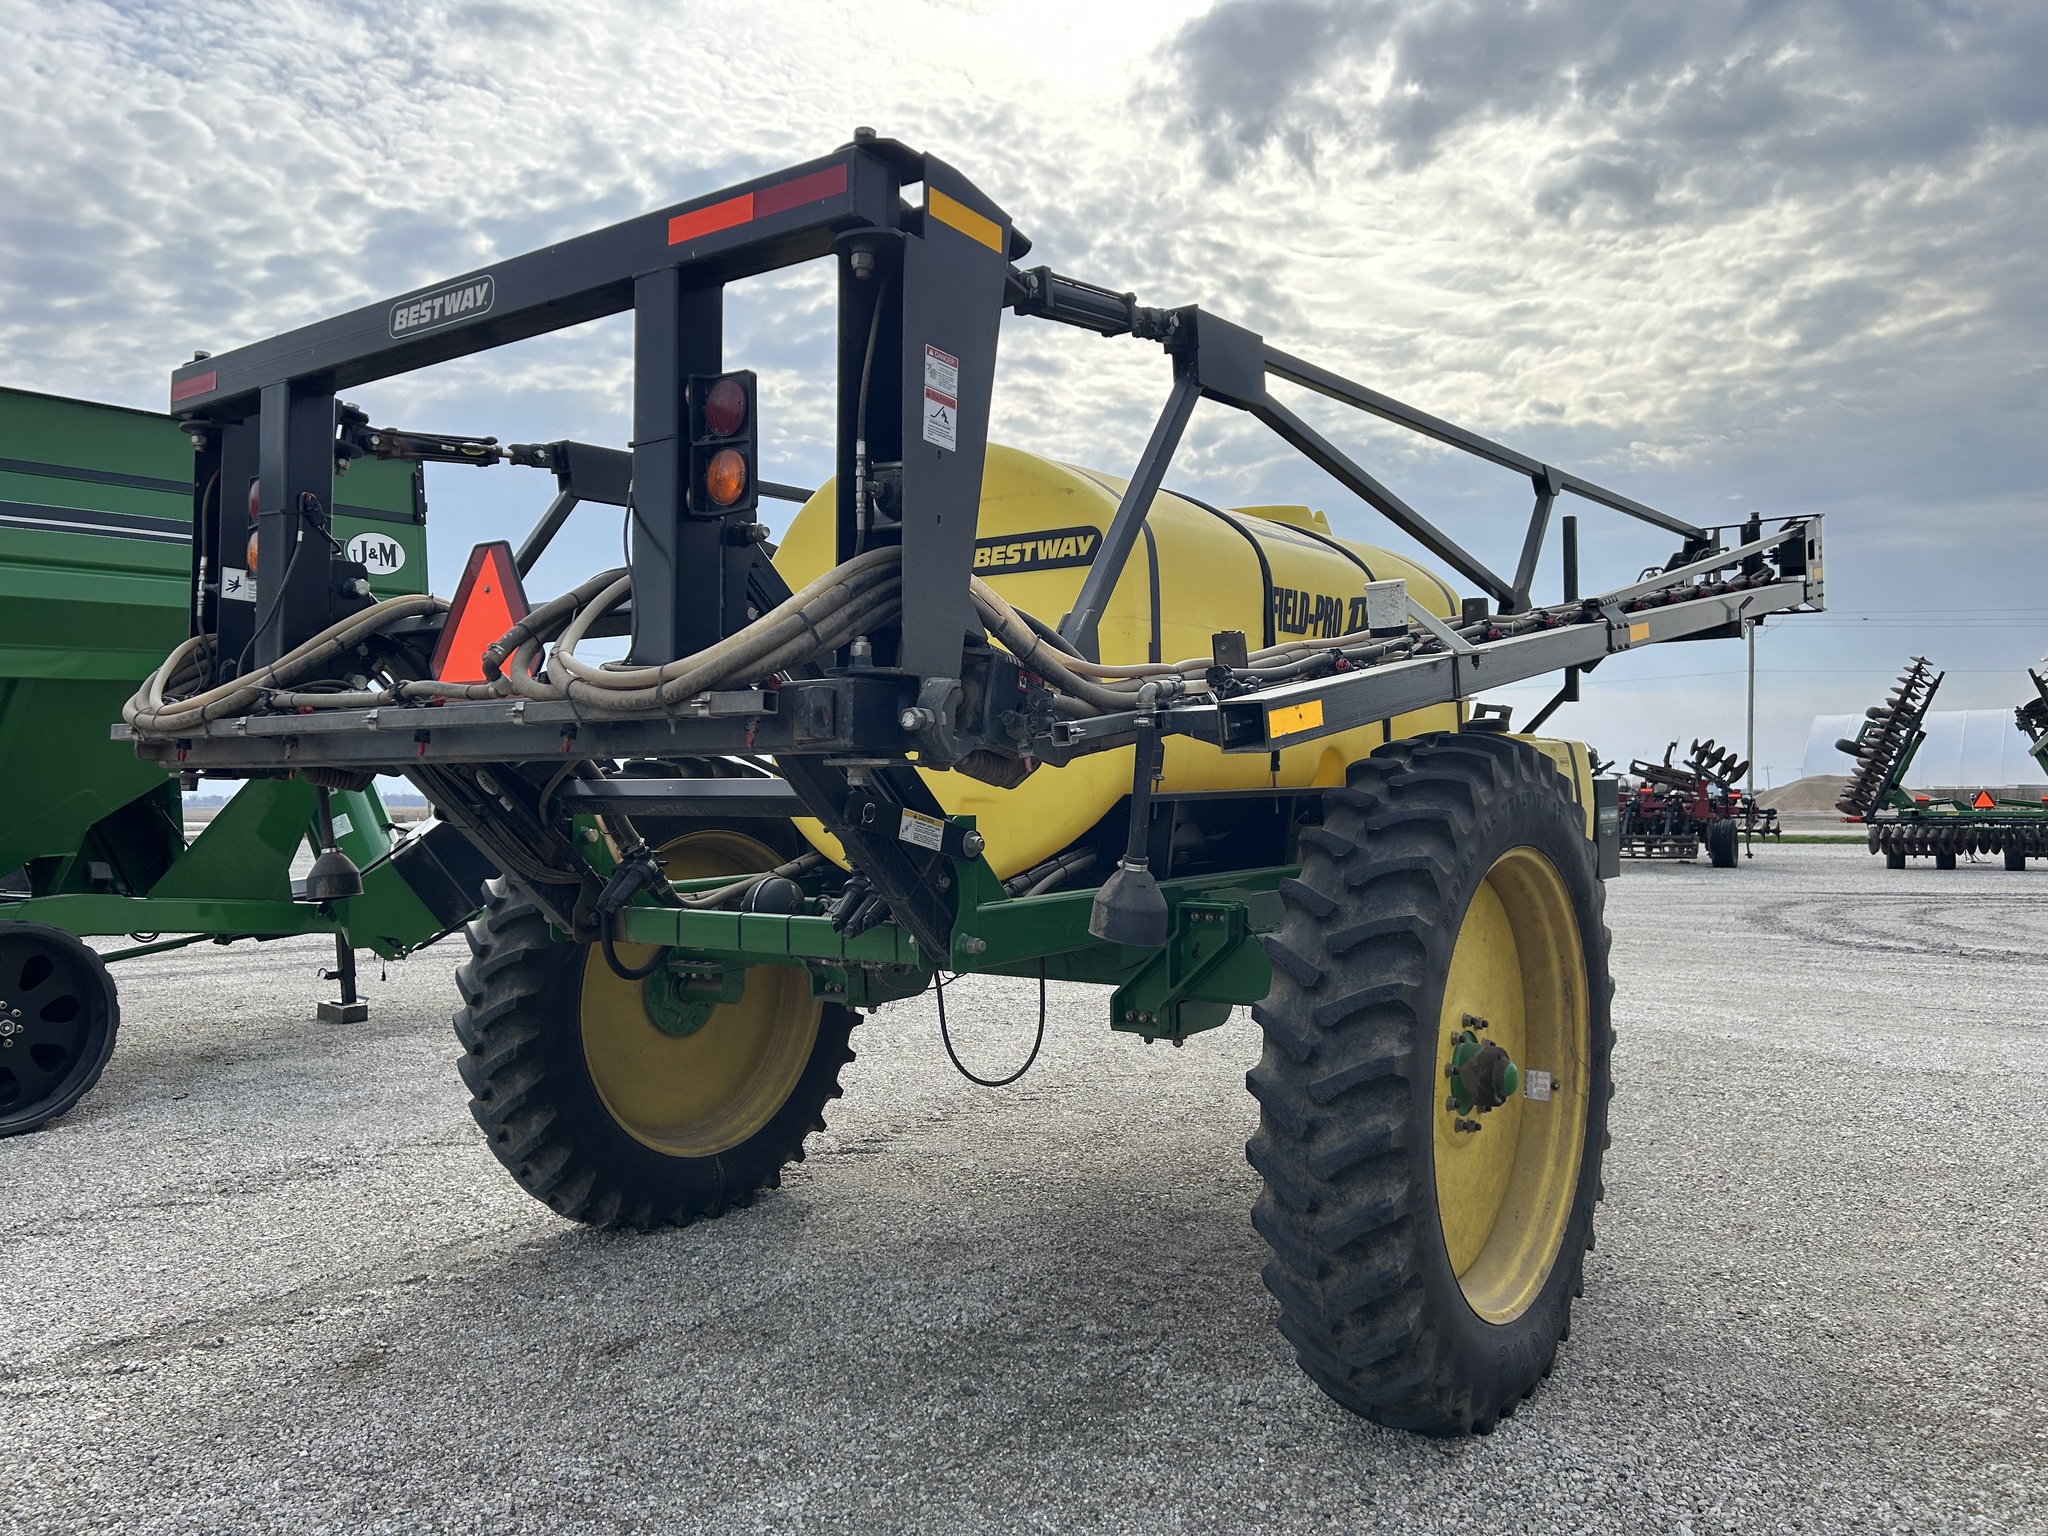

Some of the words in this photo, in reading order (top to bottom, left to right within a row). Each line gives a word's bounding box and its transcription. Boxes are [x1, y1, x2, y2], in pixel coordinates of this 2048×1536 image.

[393, 282, 489, 332] BESTWAY
[934, 351, 955, 366] DANGER
[351, 540, 397, 568] J&M
[972, 534, 1096, 568] BESTWAY
[1273, 586, 1343, 639] FIELD-PRO
